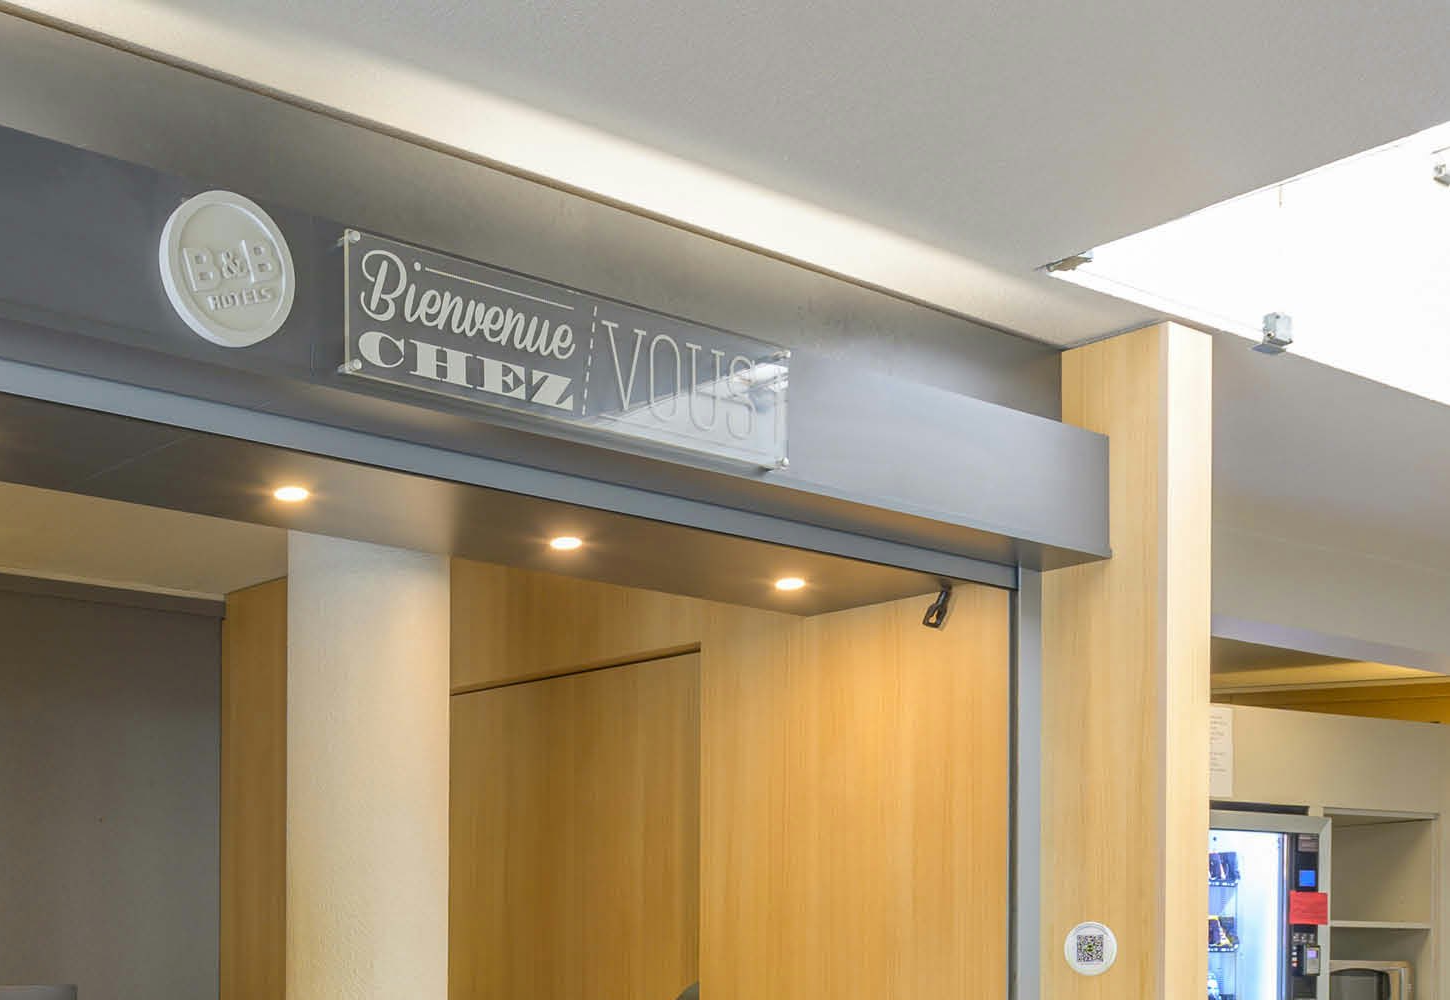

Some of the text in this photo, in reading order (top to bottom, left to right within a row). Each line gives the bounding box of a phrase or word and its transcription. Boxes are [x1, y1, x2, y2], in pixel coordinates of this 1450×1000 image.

[182, 239, 278, 292] B&B
[360, 249, 576, 360] Bienvenue
[358, 331, 574, 411] CHEZ
[601, 319, 758, 441] VOUS
